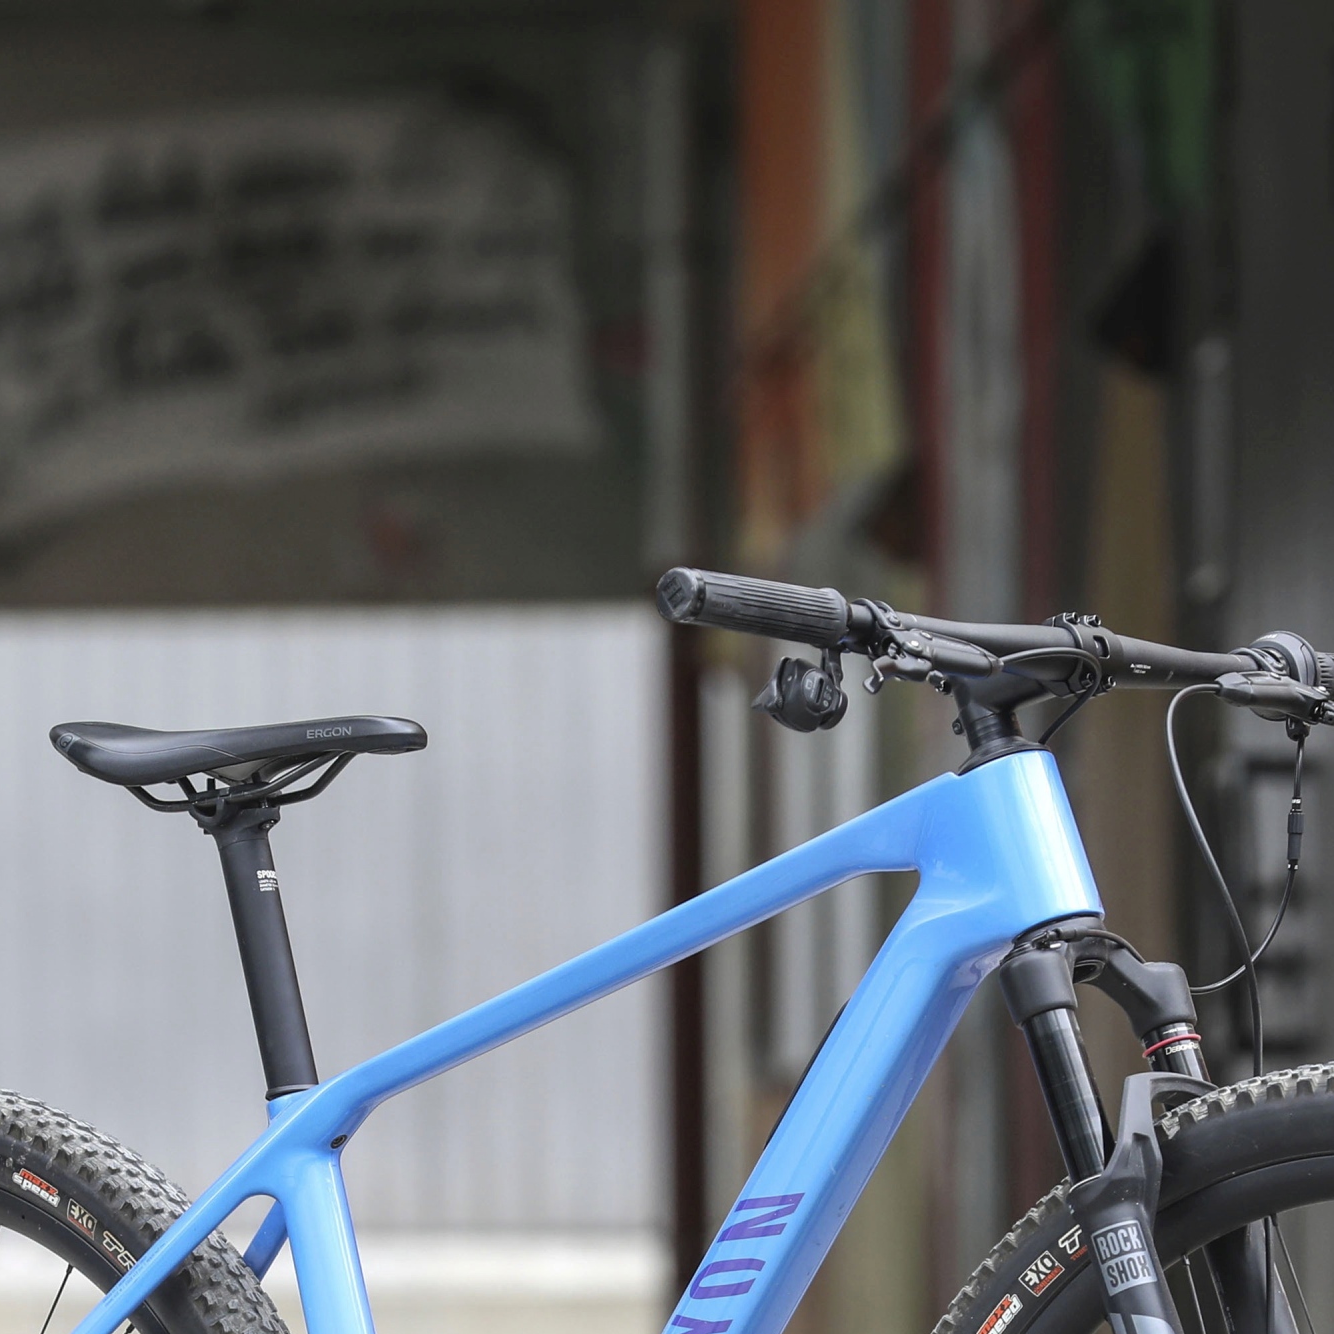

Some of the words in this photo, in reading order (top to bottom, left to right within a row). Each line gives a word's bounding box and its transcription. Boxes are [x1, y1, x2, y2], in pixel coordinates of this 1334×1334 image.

[306, 725, 352, 739] ERGON
[12, 1172, 61, 1208] speed
[69, 1202, 96, 1230] EXO
[1096, 1224, 1143, 1262] ROCK
[1022, 1255, 1056, 1288] EXO
[1106, 1254, 1151, 1288] SHOX
